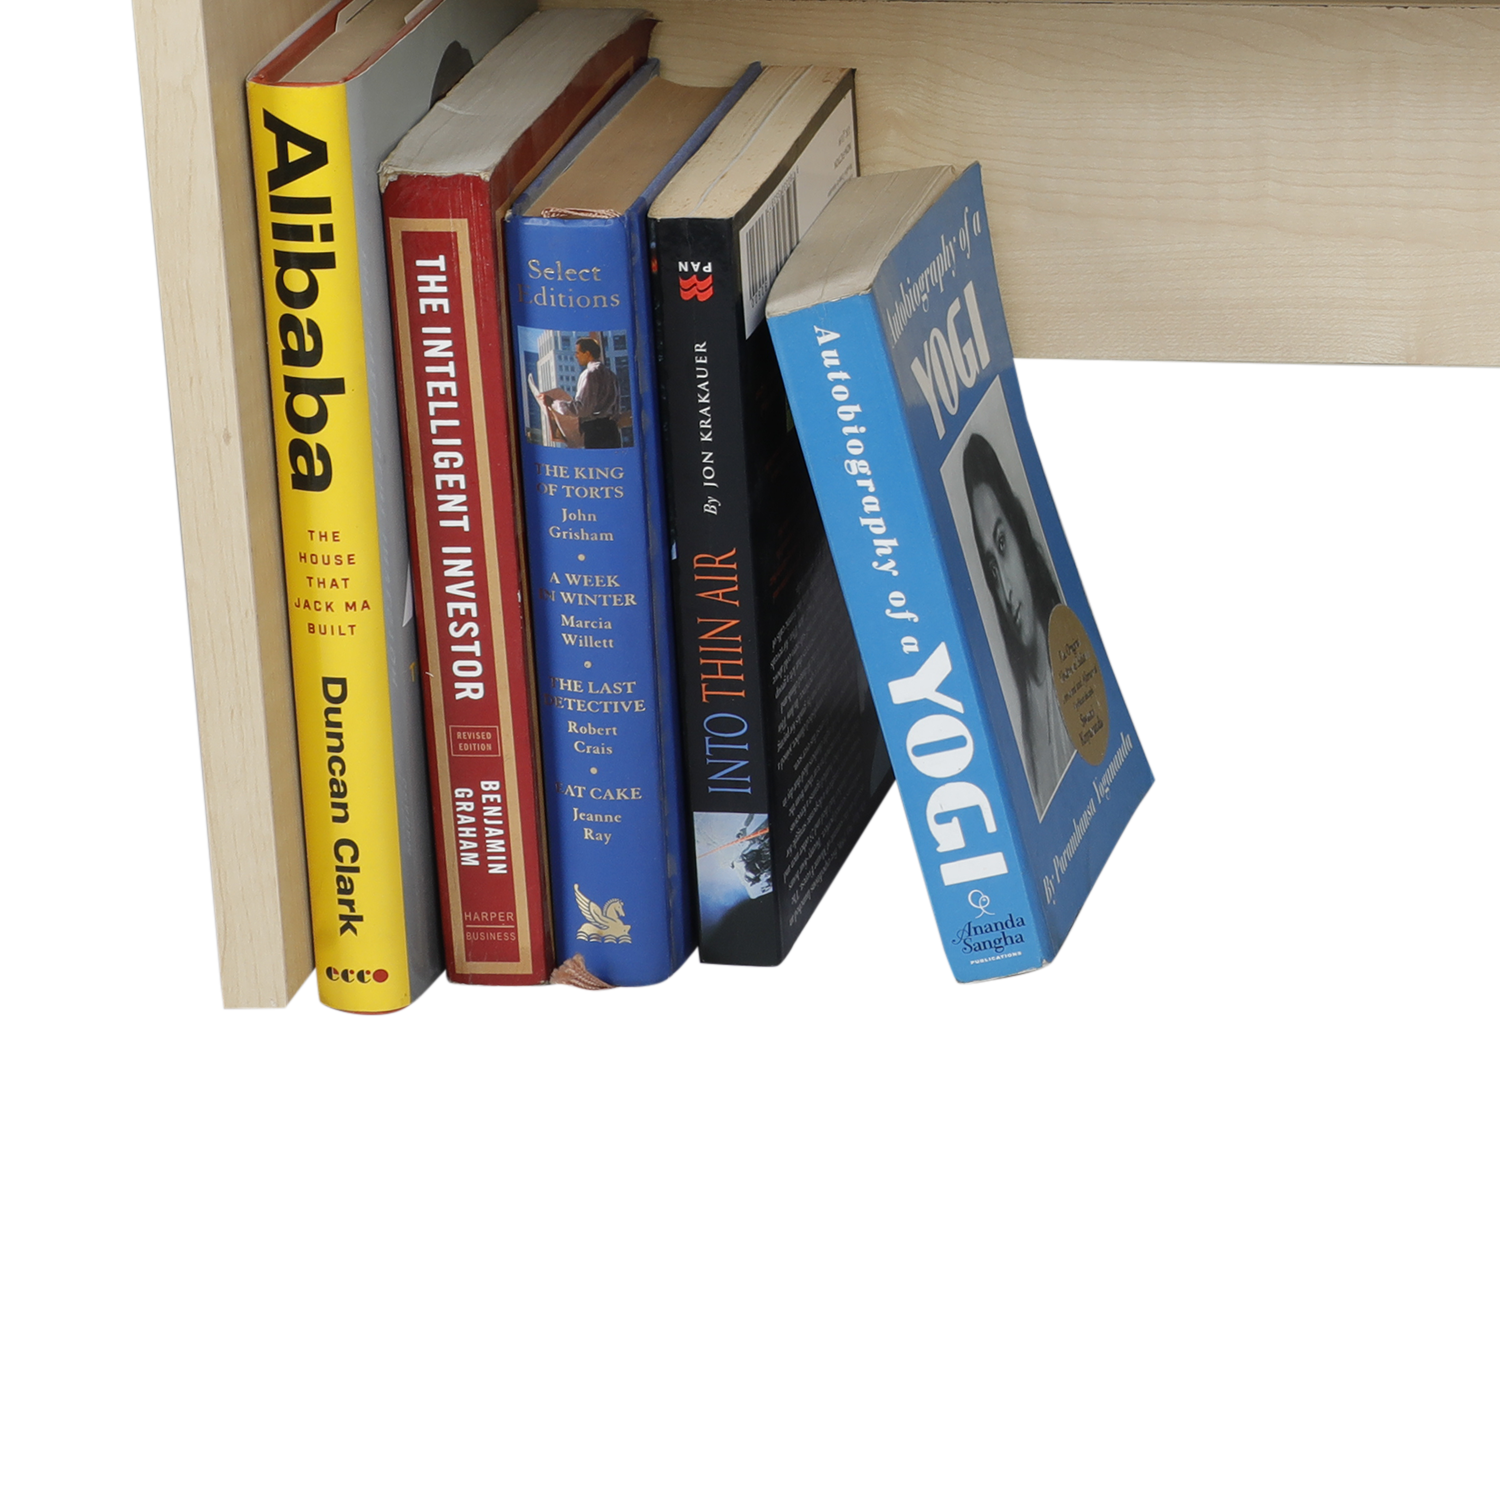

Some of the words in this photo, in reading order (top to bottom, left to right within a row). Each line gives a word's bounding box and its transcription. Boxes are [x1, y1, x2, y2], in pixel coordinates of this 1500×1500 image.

[527, 259, 602, 283] Select
[677, 260, 713, 274] PAN
[415, 254, 451, 315] THE
[890, 233, 957, 351] Autobiography
[958, 205, 974, 260] of
[972, 209, 982, 236] a
[262, 107, 346, 493] Alibaba
[517, 283, 621, 309] Editions
[910, 280, 991, 442] YOGI
[694, 340, 714, 443] KRAKAUER
[421, 326, 471, 533] INTELLIGENT
[813, 324, 902, 578] Autobiography
[535, 461, 570, 480] THE
[573, 466, 625, 481] KING
[702, 450, 719, 489] JON
[535, 481, 558, 496] OF
[560, 484, 625, 500] TORTS
[561, 507, 598, 523] John
[702, 495, 722, 516] By
[306, 529, 341, 542] THE
[548, 525, 615, 542] Grisham
[298, 551, 356, 566] HOUSE
[305, 575, 350, 590] THAT
[549, 572, 562, 585] A
[565, 573, 621, 588] WEEK
[693, 547, 740, 608] AIR
[294, 595, 337, 612] JACK
[344, 598, 371, 613] MA
[538, 587, 556, 603] IN
[560, 590, 638, 607] WINTER
[885, 590, 919, 624] of
[306, 622, 357, 637] BUILT
[441, 545, 486, 701] INVESTOR
[560, 614, 613, 630] Marcia
[561, 632, 614, 649] Willett
[900, 635, 920, 656] a
[696, 616, 746, 703] THIN
[550, 675, 584, 694] THE
[588, 680, 637, 695] LAST
[544, 693, 647, 714] DETECTIVE
[456, 730, 492, 741] REVISED
[567, 720, 618, 737] Robert
[321, 675, 350, 824] Duncan
[458, 740, 493, 752] EDITION
[573, 739, 613, 756] Crais
[703, 712, 752, 795] INTO
[887, 641, 1009, 887] YOGI
[555, 781, 586, 799] EAT
[590, 786, 643, 801] CAKE
[572, 807, 622, 824] Jeanne
[1042, 874, 1056, 906] By
[1094, 731, 1134, 804] Yogananda
[454, 787, 480, 868] GRAHAM
[479, 779, 508, 875] BENJAMIN
[583, 826, 612, 846] Ray
[333, 836, 364, 937] Clark
[463, 911, 515, 923] HARPER
[465, 930, 517, 942] BUSINESS
[951, 912, 1027, 946] Ananda
[962, 931, 1026, 954] Sangha
[970, 950, 1023, 965] PUBLICATIONS
